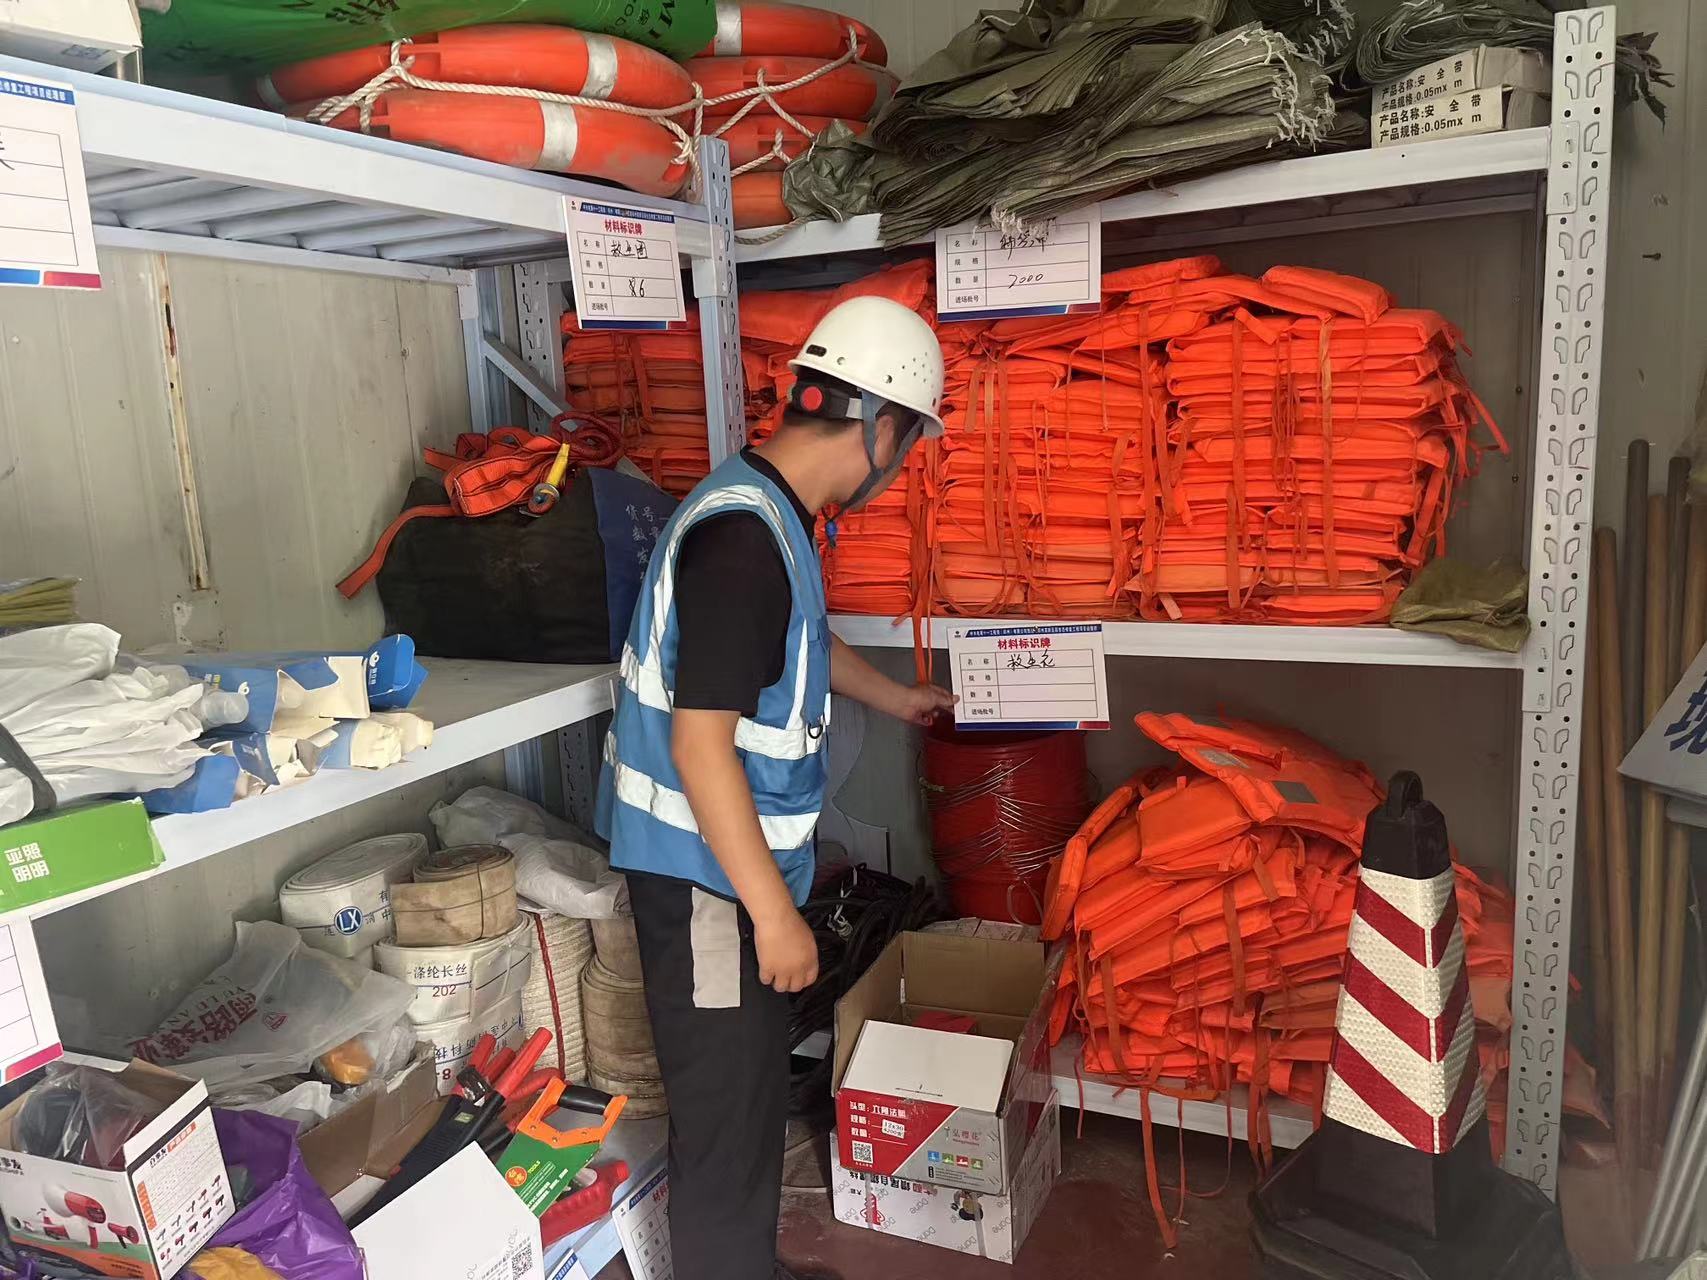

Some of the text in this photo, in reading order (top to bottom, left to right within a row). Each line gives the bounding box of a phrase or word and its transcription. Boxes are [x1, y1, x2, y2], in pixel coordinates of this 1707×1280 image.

[1379, 114, 1482, 143] 产品规格:0.05mx m
[604, 219, 644, 236] 材料标识牌
[955, 295, 979, 304] 进场批号
[997, 638, 1051, 650] 材料标识牌
[339, 911, 360, 931] LX
[432, 984, 457, 998] 202
